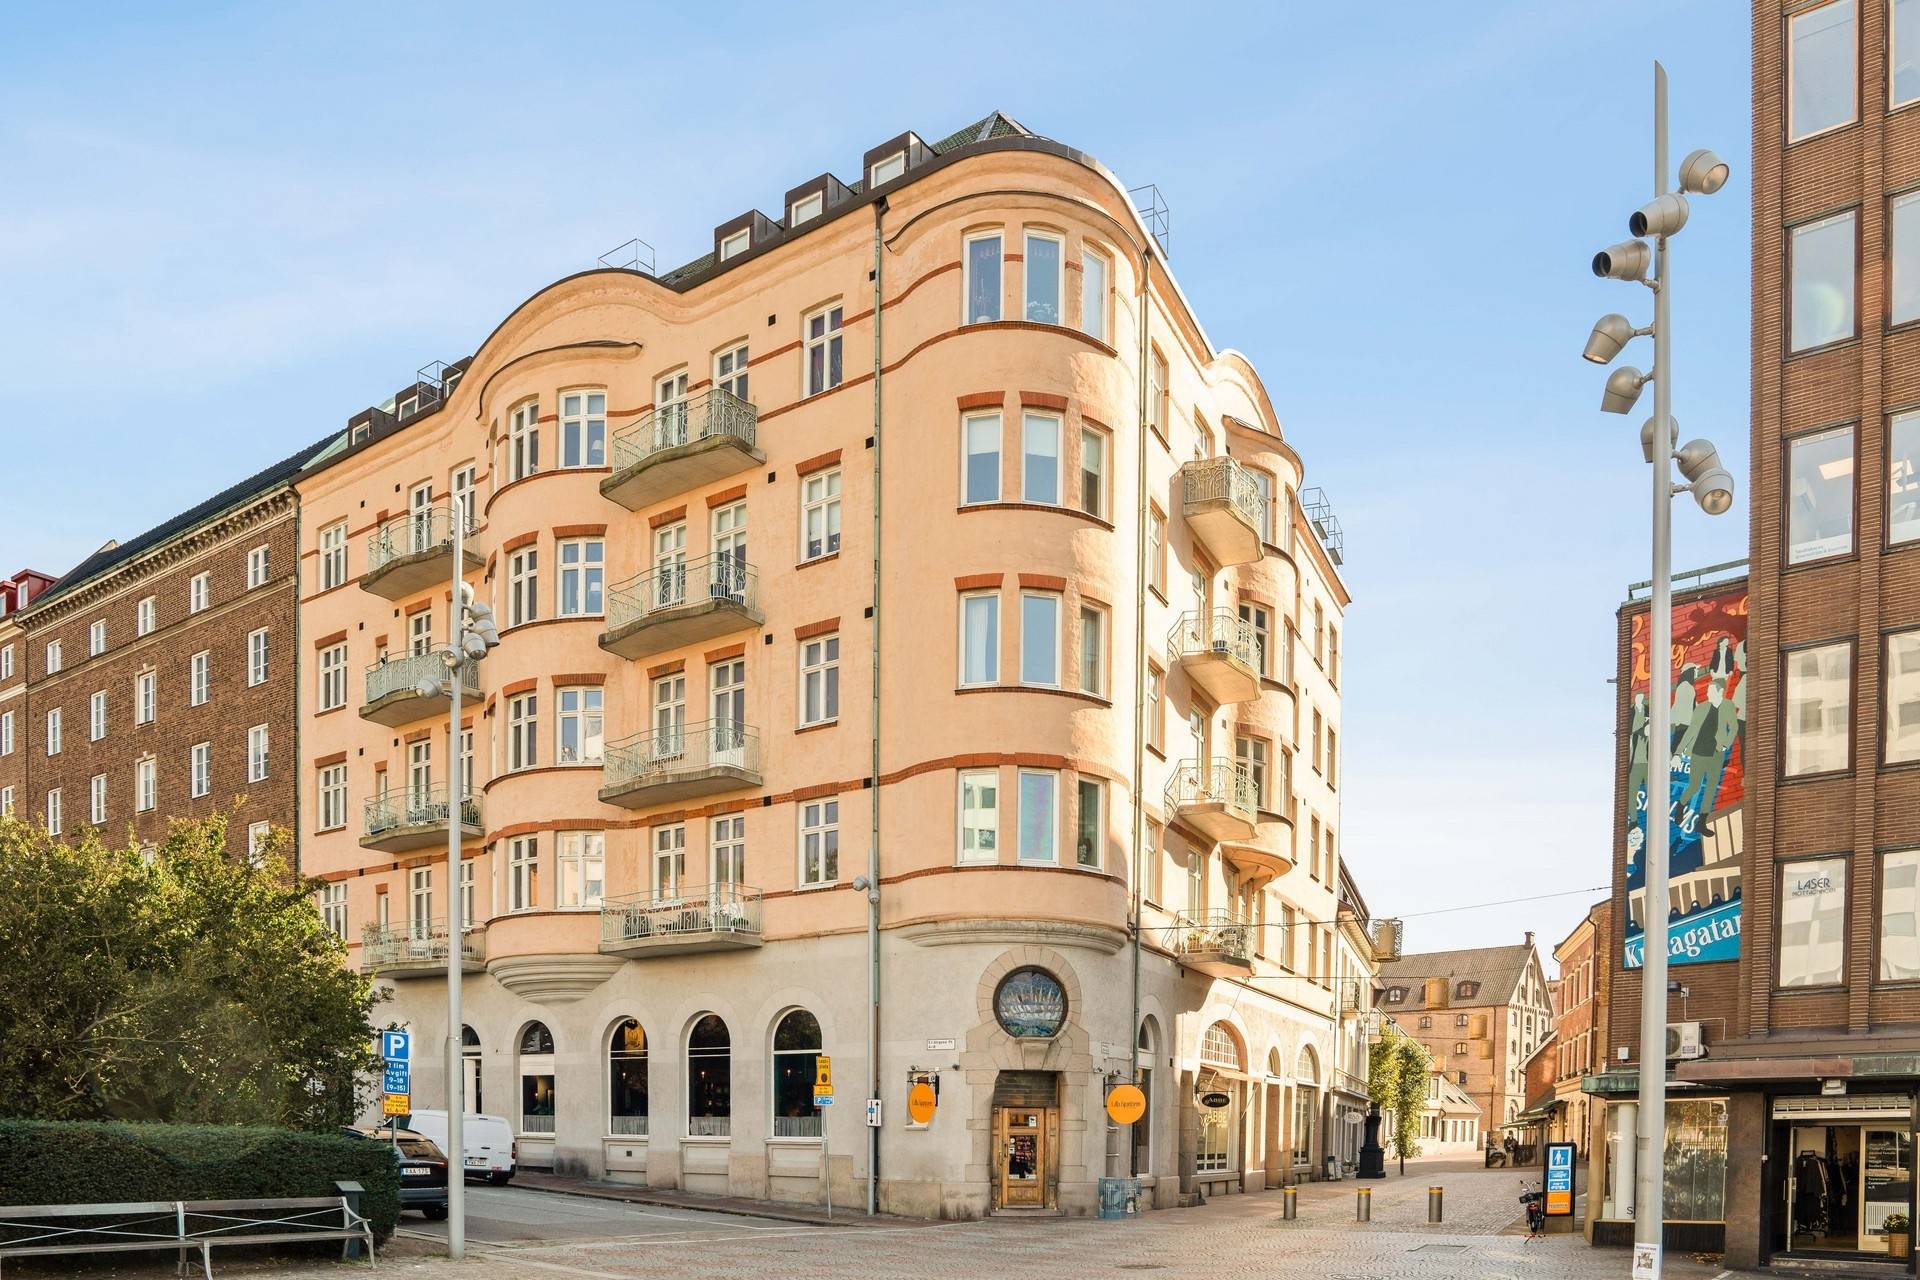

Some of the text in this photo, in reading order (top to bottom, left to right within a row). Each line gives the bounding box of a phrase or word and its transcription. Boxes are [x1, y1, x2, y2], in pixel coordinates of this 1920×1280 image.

[1797, 877, 1831, 890] LASER
[1624, 914, 1741, 967] Kagata
[390, 1034, 405, 1057] P
[385, 1069, 407, 1078] Avgift
[388, 1076, 404, 1084] 9-18
